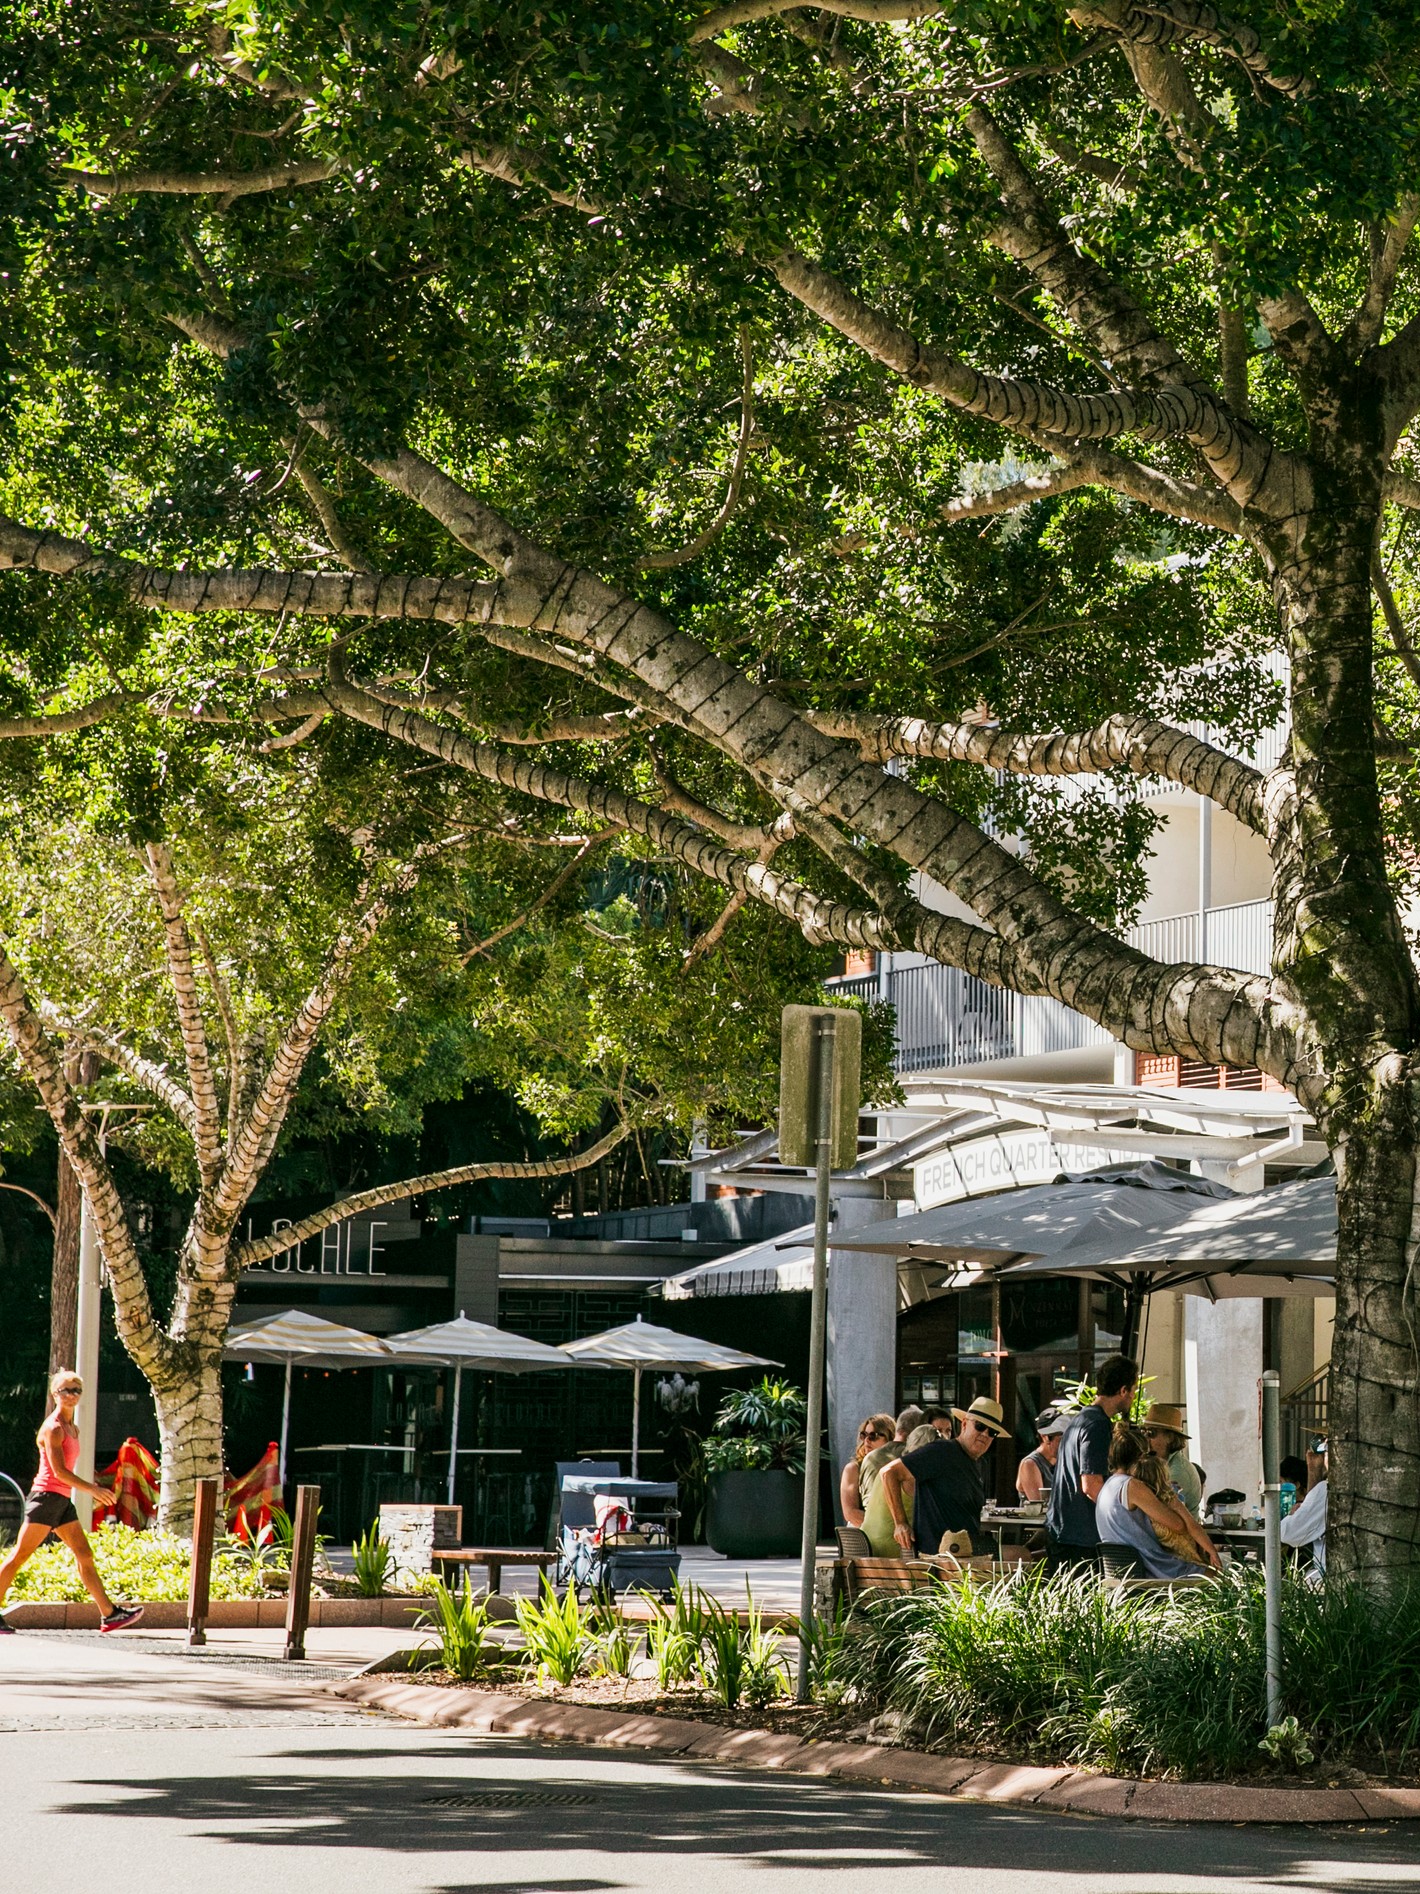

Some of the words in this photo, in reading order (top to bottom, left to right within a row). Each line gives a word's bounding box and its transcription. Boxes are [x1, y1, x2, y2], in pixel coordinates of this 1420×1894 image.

[922, 1154, 986, 1197] FRENCH
[989, 1140, 1071, 1177] QUARTER
[246, 1217, 388, 1276] LOCALE
